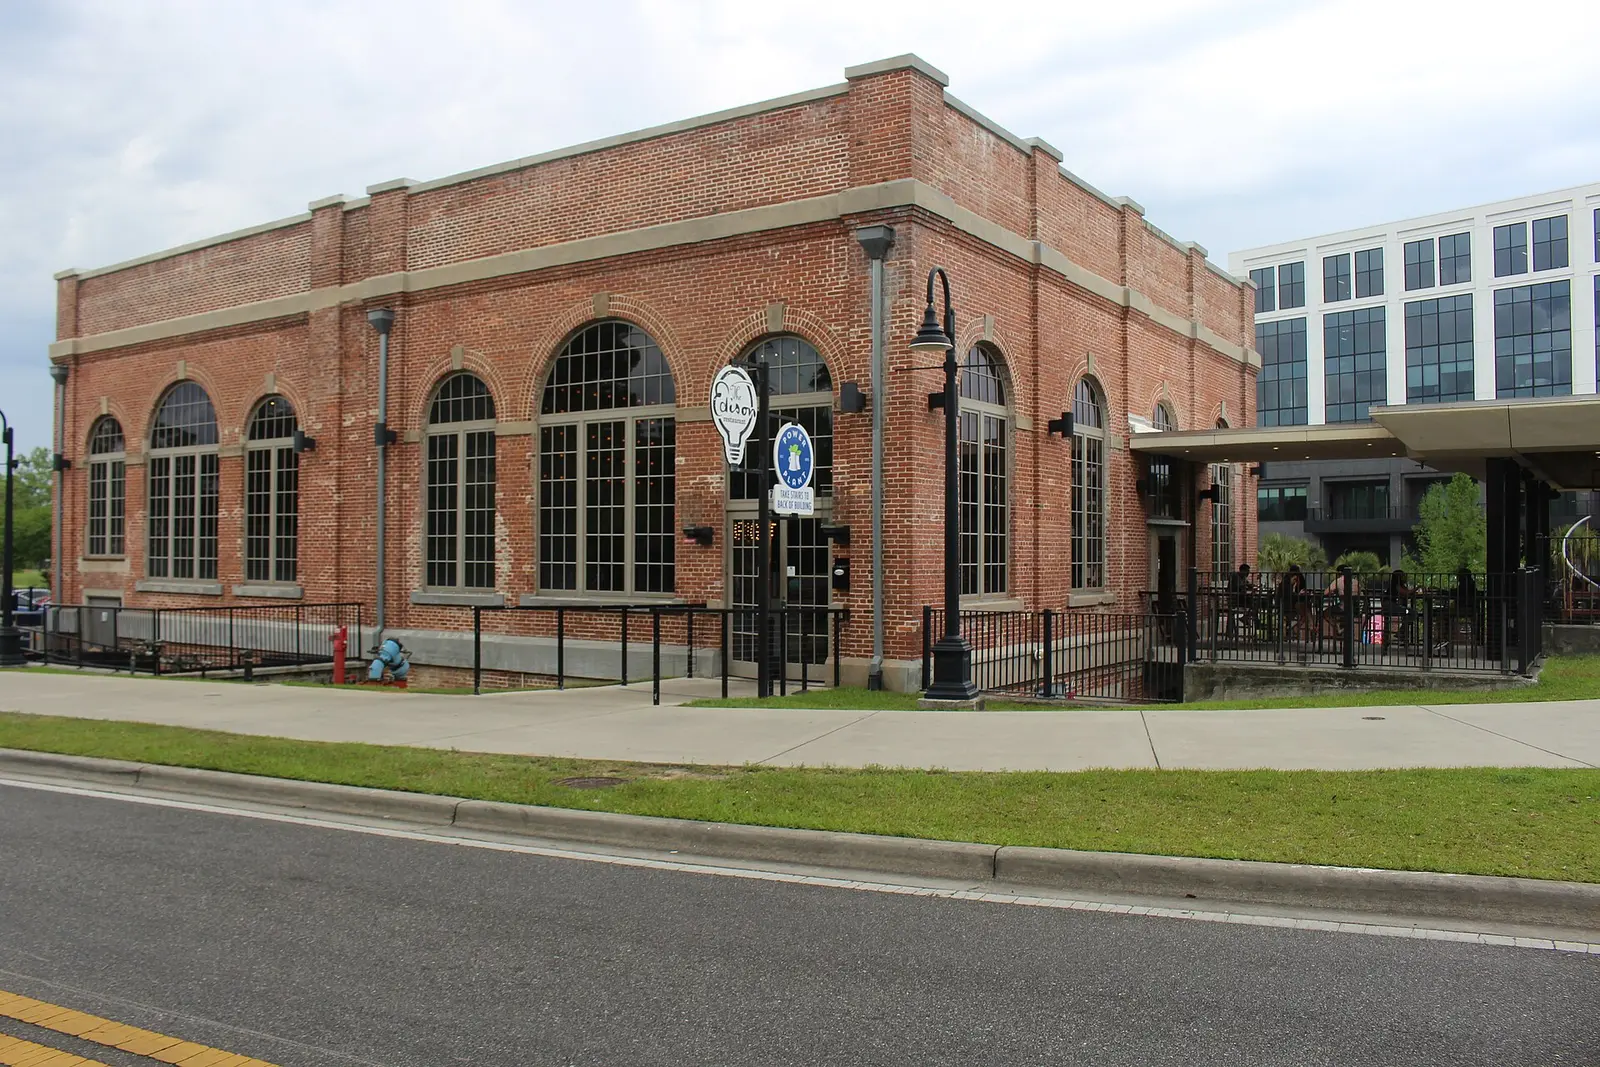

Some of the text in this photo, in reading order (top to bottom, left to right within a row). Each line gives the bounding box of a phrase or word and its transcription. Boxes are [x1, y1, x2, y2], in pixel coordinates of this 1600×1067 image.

[713, 381, 756, 418] Edison
[783, 430, 807, 448] POWER
[783, 470, 806, 486] PLANT
[781, 490, 809, 500] TAKE STAIRS TO
[777, 500, 812, 510] BACK OF BUILDING
